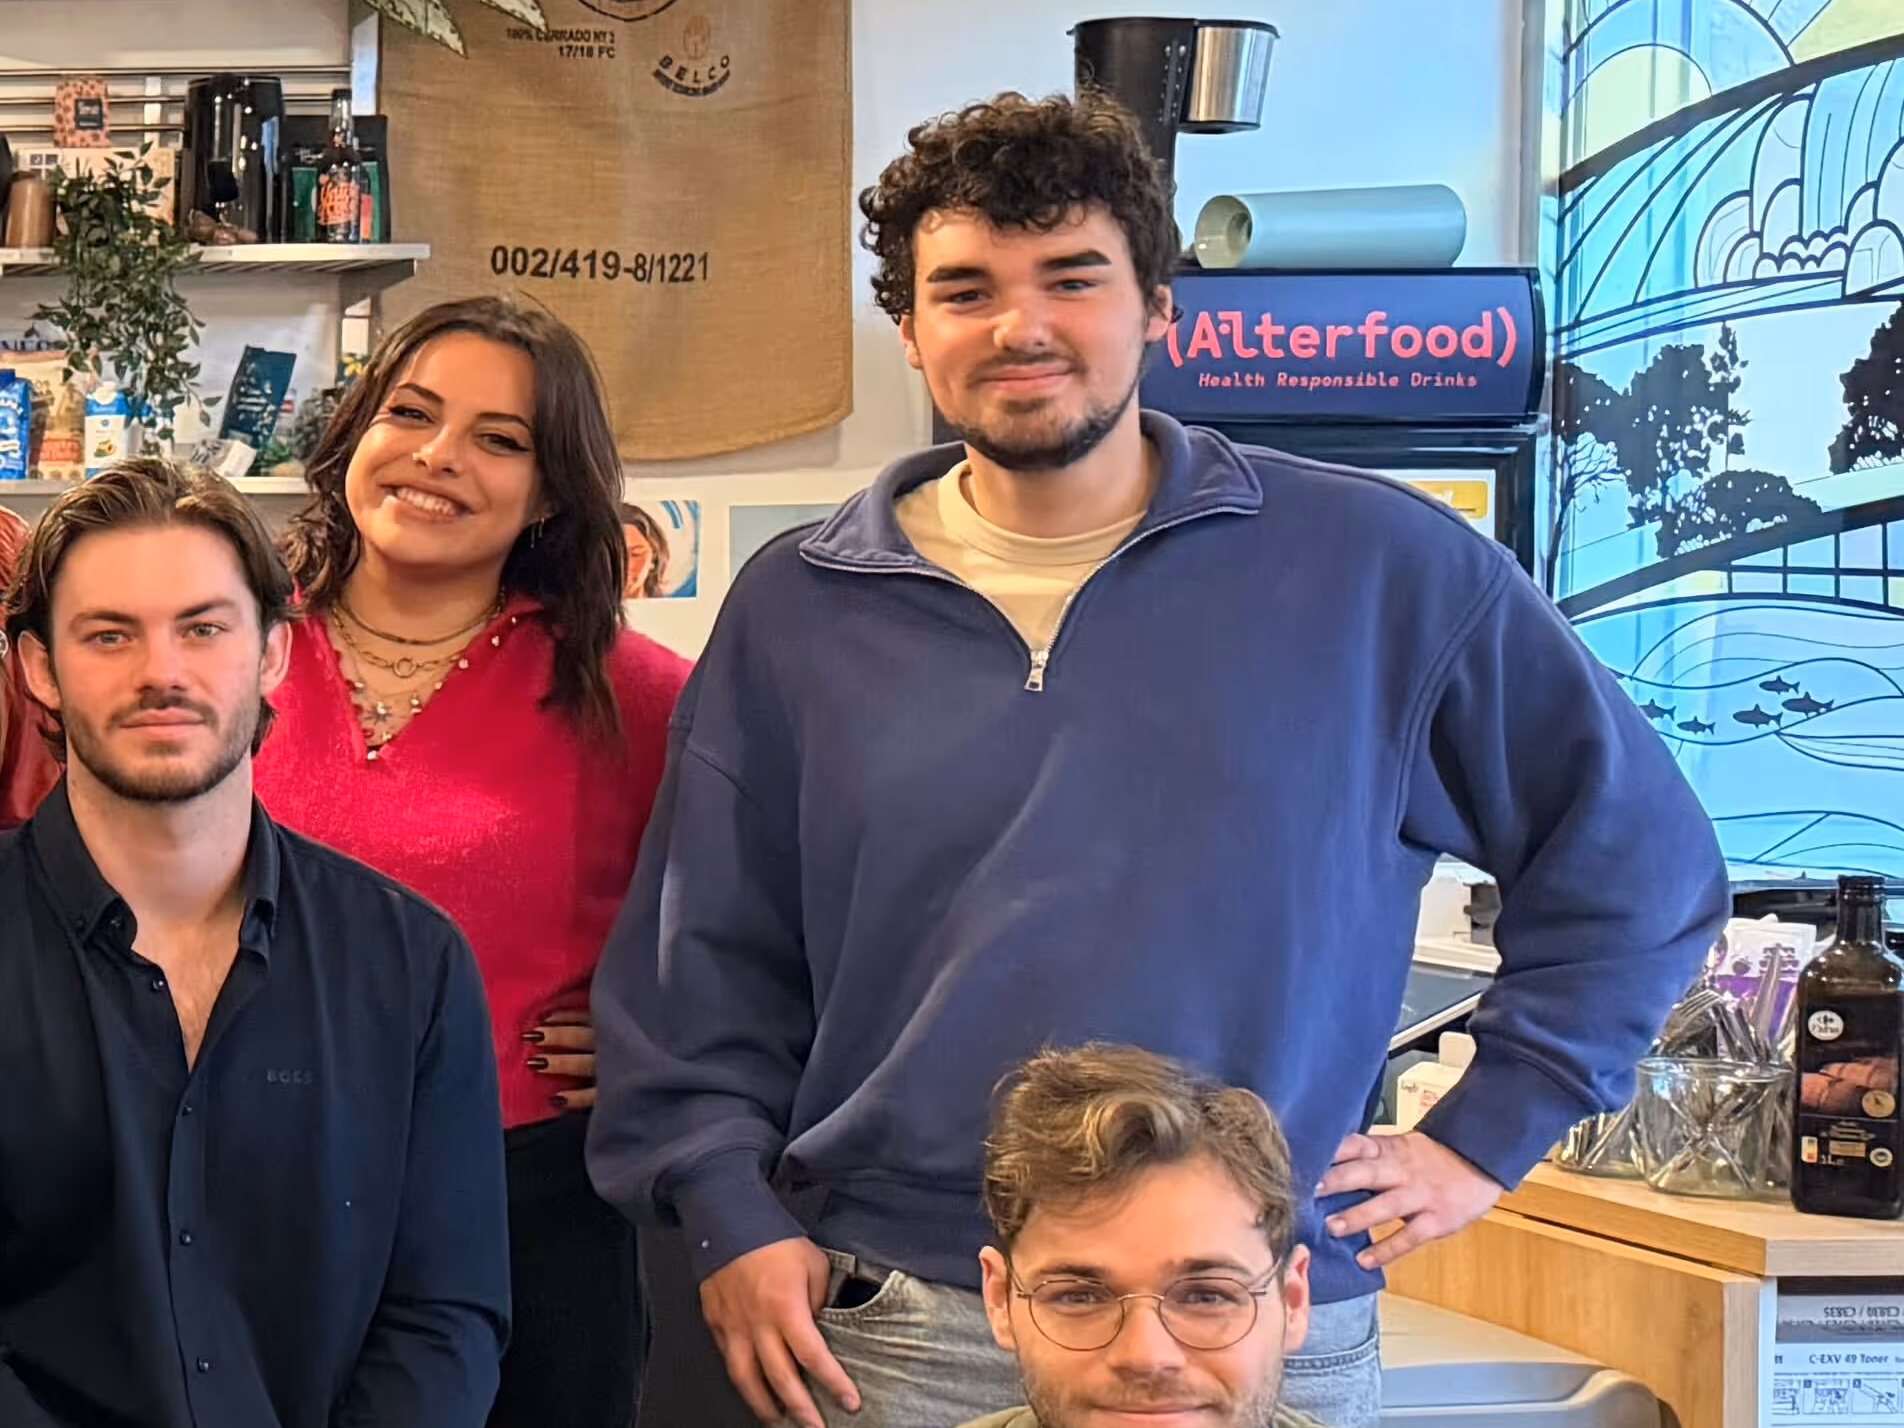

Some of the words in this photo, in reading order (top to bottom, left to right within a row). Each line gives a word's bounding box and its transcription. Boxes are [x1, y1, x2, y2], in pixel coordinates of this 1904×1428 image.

[659, 55, 731, 84] BELCO
[1198, 371, 1265, 388] Health
[1276, 371, 1400, 392] Responsible
[1410, 371, 1480, 388] Drinks
[1809, 1354, 1842, 1364] C-EXV
[1844, 1354, 1857, 1364] 49
[1860, 1354, 1889, 1364] Toner
